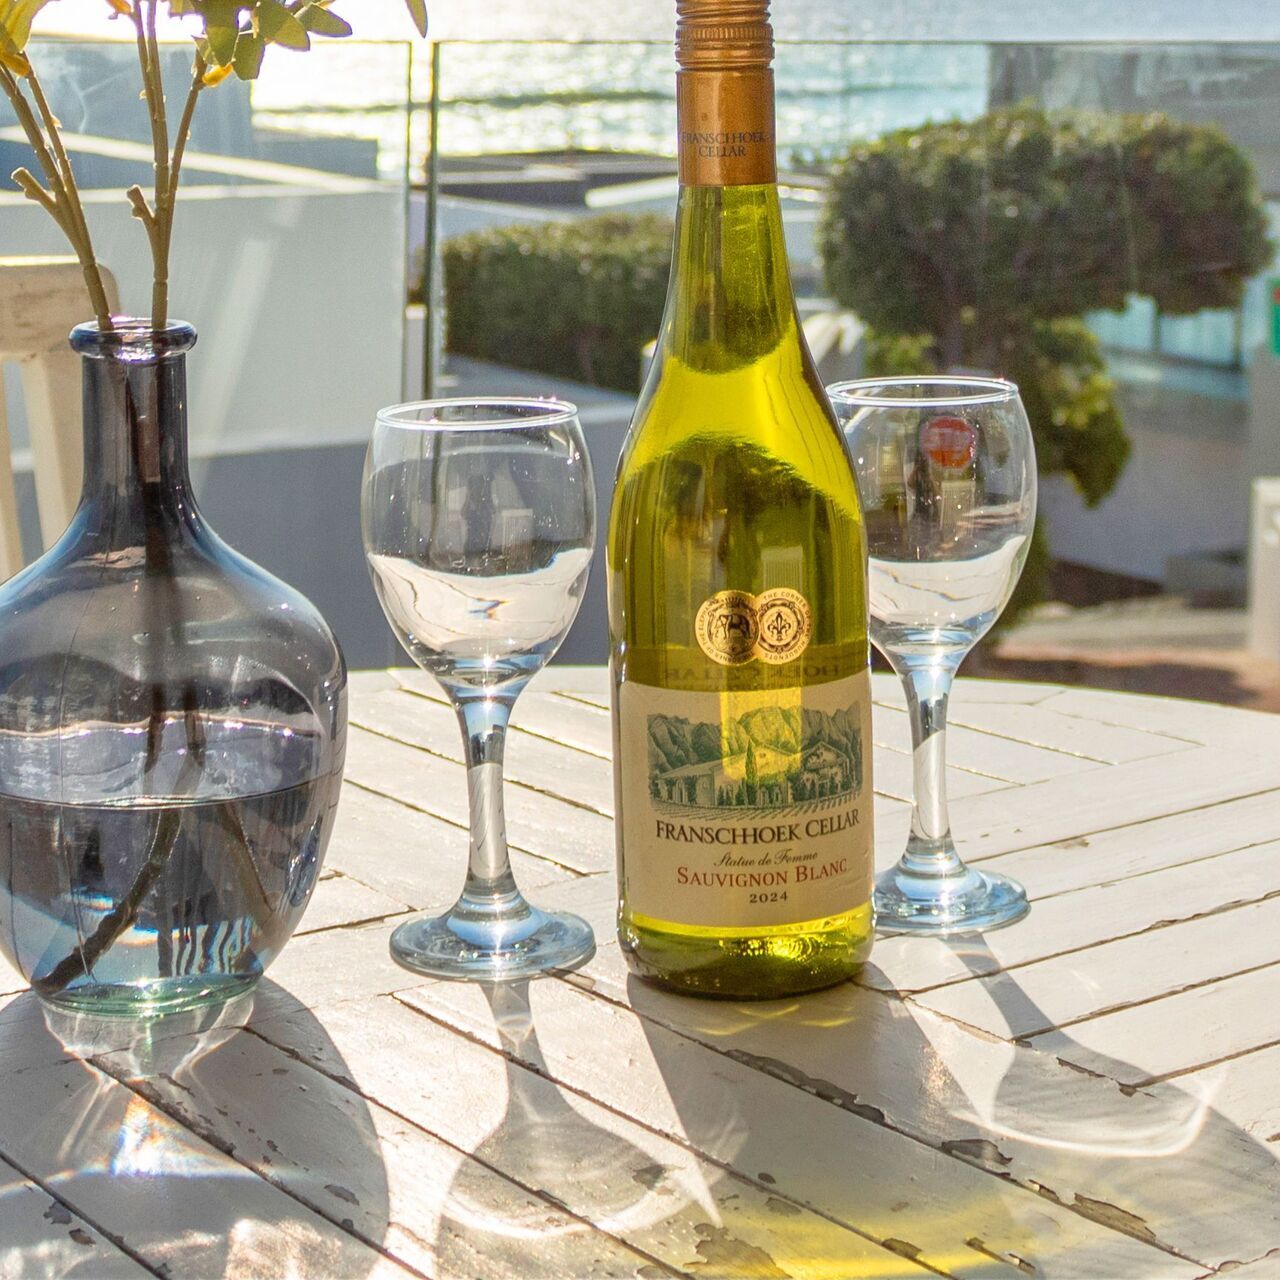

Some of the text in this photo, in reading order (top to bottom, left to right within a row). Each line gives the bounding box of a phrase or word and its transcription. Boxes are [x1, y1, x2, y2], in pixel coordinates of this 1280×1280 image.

[681, 131, 766, 145] FRANSCHHOEK
[698, 146, 747, 158] CELLAR
[781, 591, 807, 608] CORNER
[763, 640, 807, 661] HUGUENOTS
[656, 808, 860, 846] FRANSCHHOEK CELLAR
[713, 848, 818, 868] Statue de Femme
[677, 858, 848, 888] SAUVIGNON BLANC
[749, 890, 788, 904] 2024
